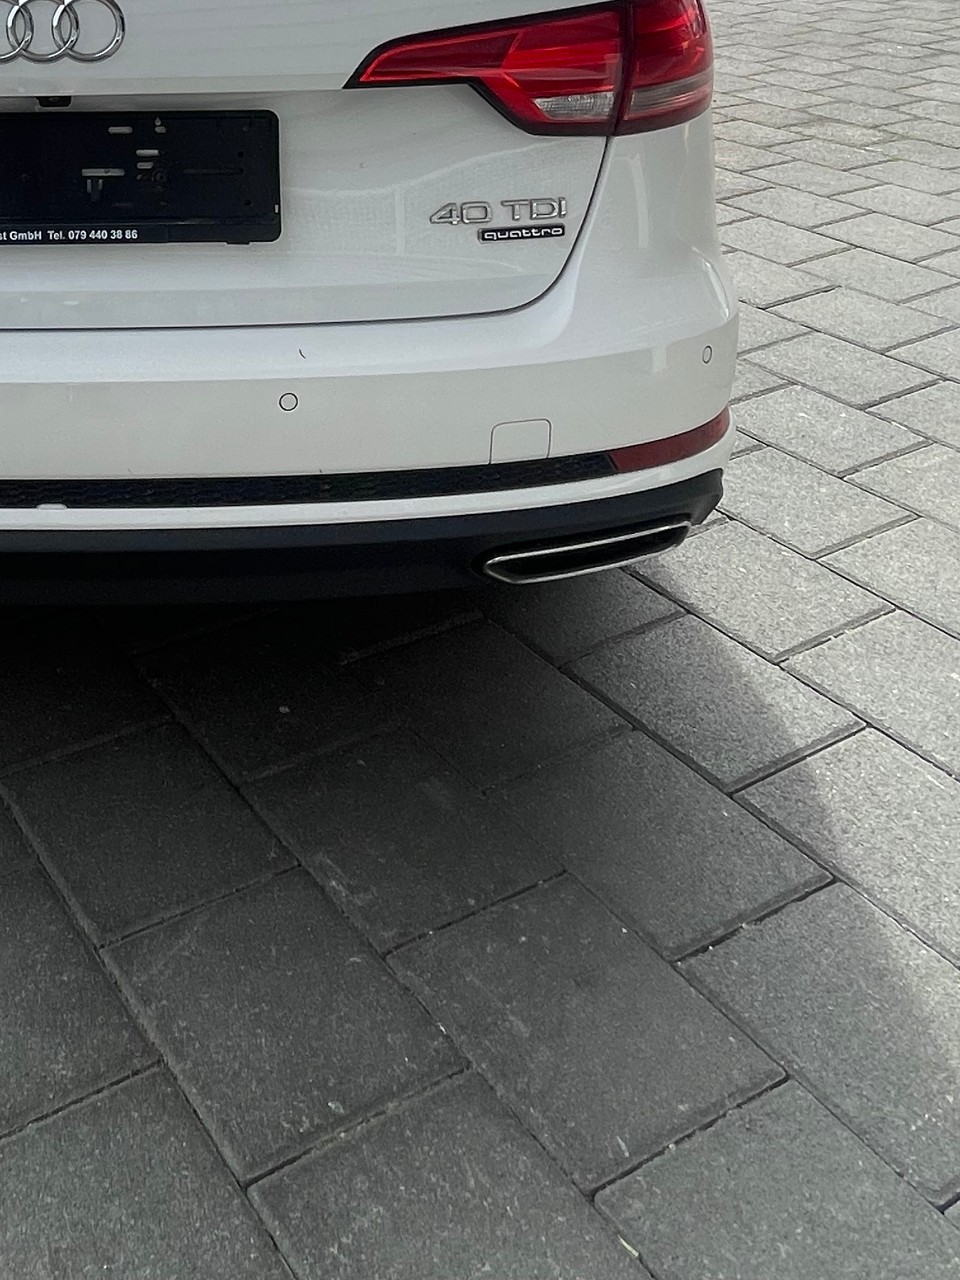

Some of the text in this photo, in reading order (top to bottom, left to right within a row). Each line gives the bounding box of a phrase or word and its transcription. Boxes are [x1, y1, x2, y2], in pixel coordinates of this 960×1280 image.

[429, 196, 567, 225] 40 TDI
[9, 230, 42, 241] GmbH
[47, 229, 66, 240] Tel.
[67, 229, 87, 240] 079
[88, 229, 108, 240] 440
[109, 229, 123, 240] 38
[124, 229, 138, 240] 86
[483, 226, 564, 241] quattro
